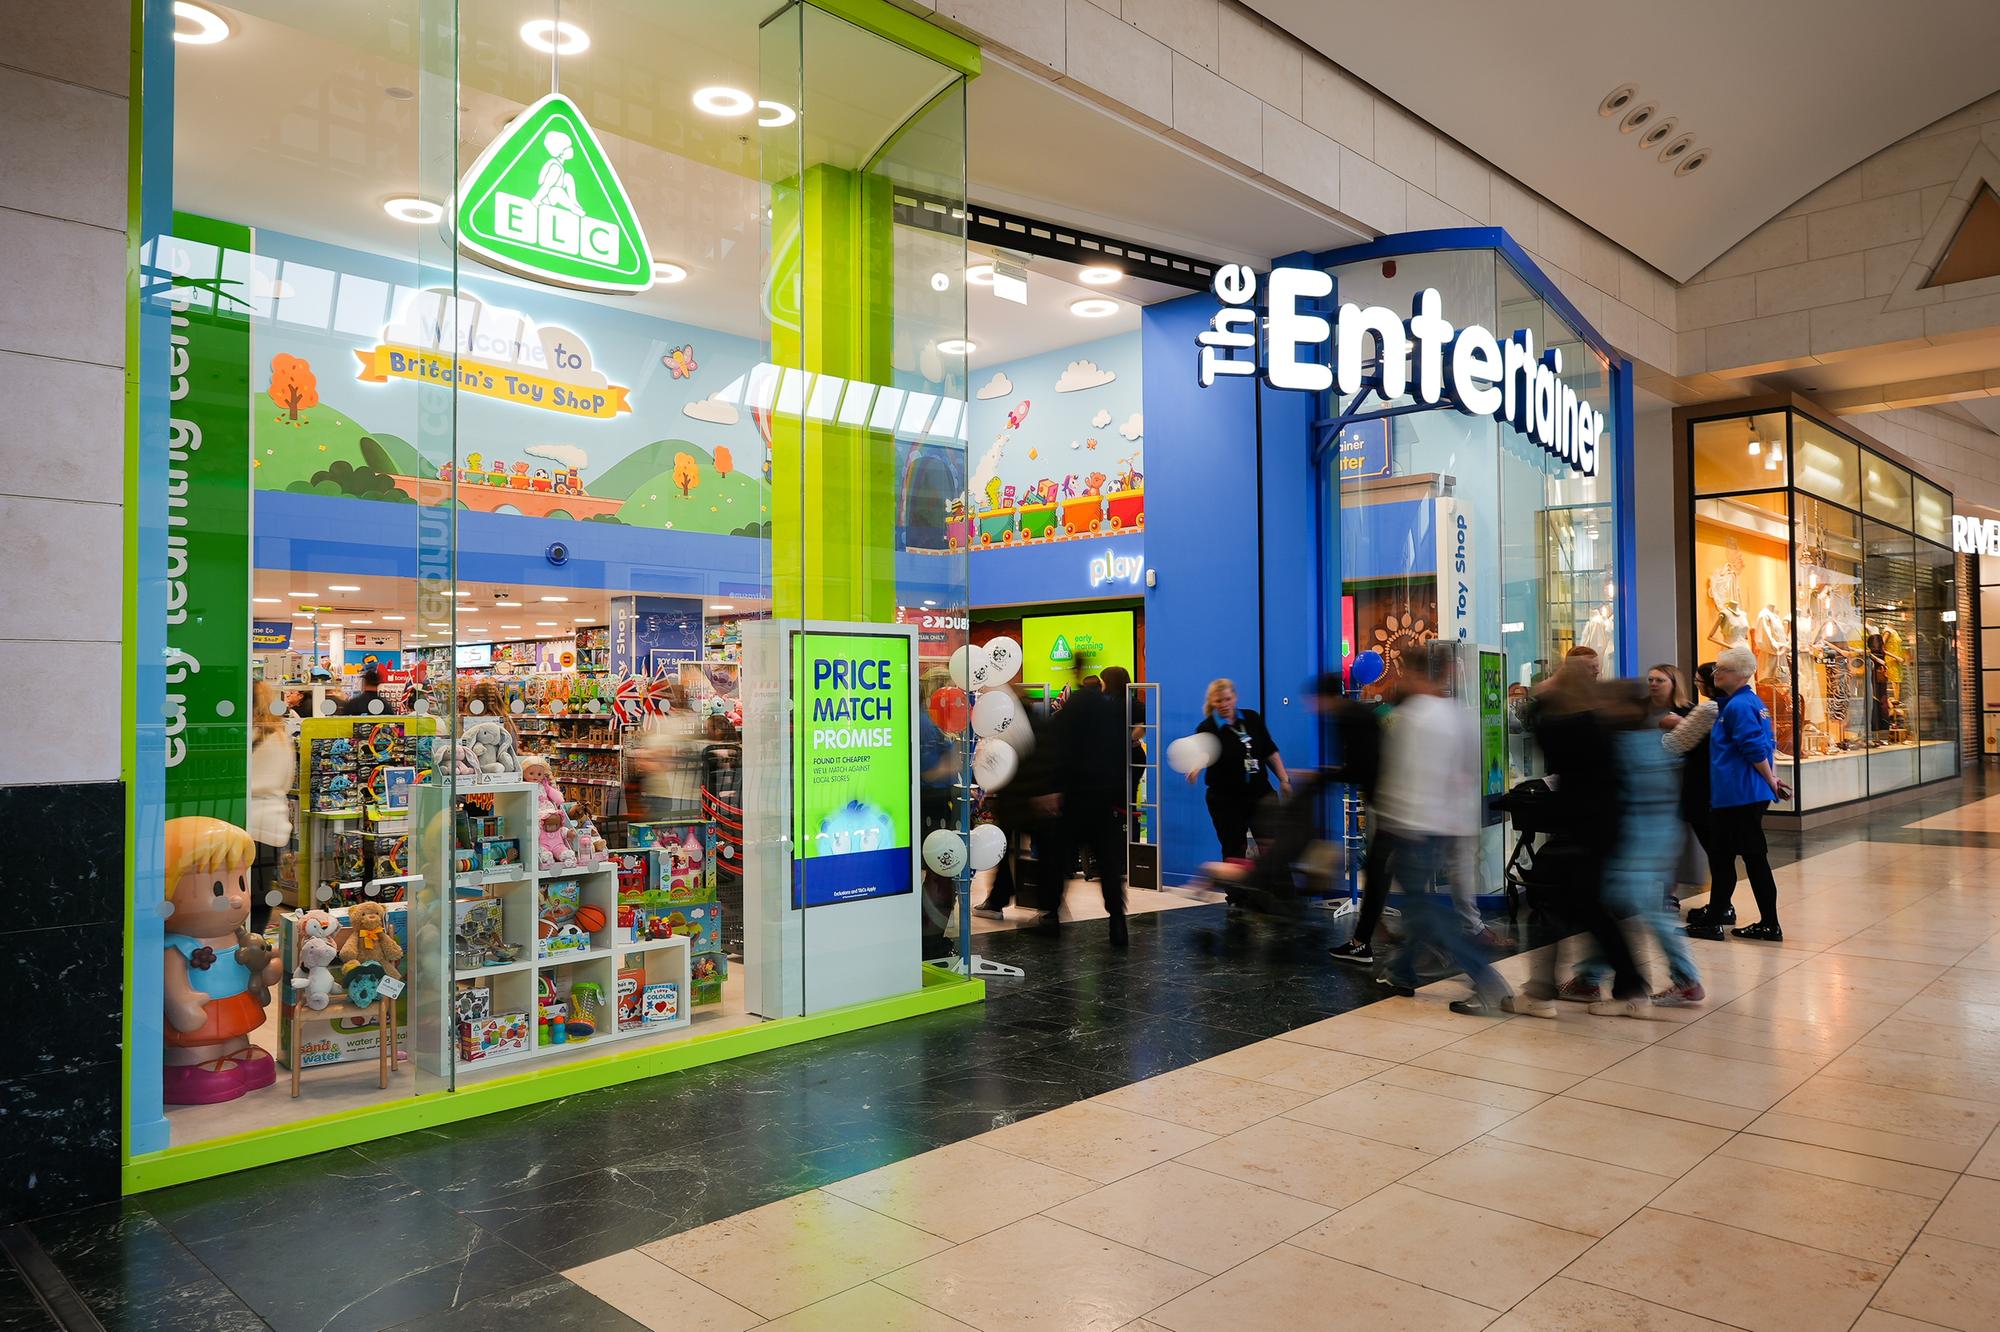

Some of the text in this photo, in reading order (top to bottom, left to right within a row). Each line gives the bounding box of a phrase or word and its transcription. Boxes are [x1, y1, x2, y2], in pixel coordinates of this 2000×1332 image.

[508, 203, 610, 255] ELC
[554, 343, 582, 370] to
[389, 351, 606, 414] Britain's Toy Shop
[1198, 263, 1604, 478] The Entertainer
[1455, 514, 1468, 574] Shop
[1090, 549, 1144, 587] play
[1456, 581, 1469, 619] Toy
[617, 608, 628, 655] Shop
[1074, 634, 1092, 643] early
[1074, 642, 1104, 651] learning
[656, 657, 671, 665] TOY
[813, 658, 892, 690] PRICE
[812, 696, 892, 722] MATCH
[813, 726, 893, 750] PROMISE
[813, 757, 835, 765] FOUND
[842, 755, 871, 764] CHEAPER?
[848, 764, 871, 772] AGAINST
[813, 775, 850, 784] LOCAL STORES
[300, 1041, 331, 1054] sand
[346, 1037, 373, 1047] water
[303, 1051, 342, 1064] water
